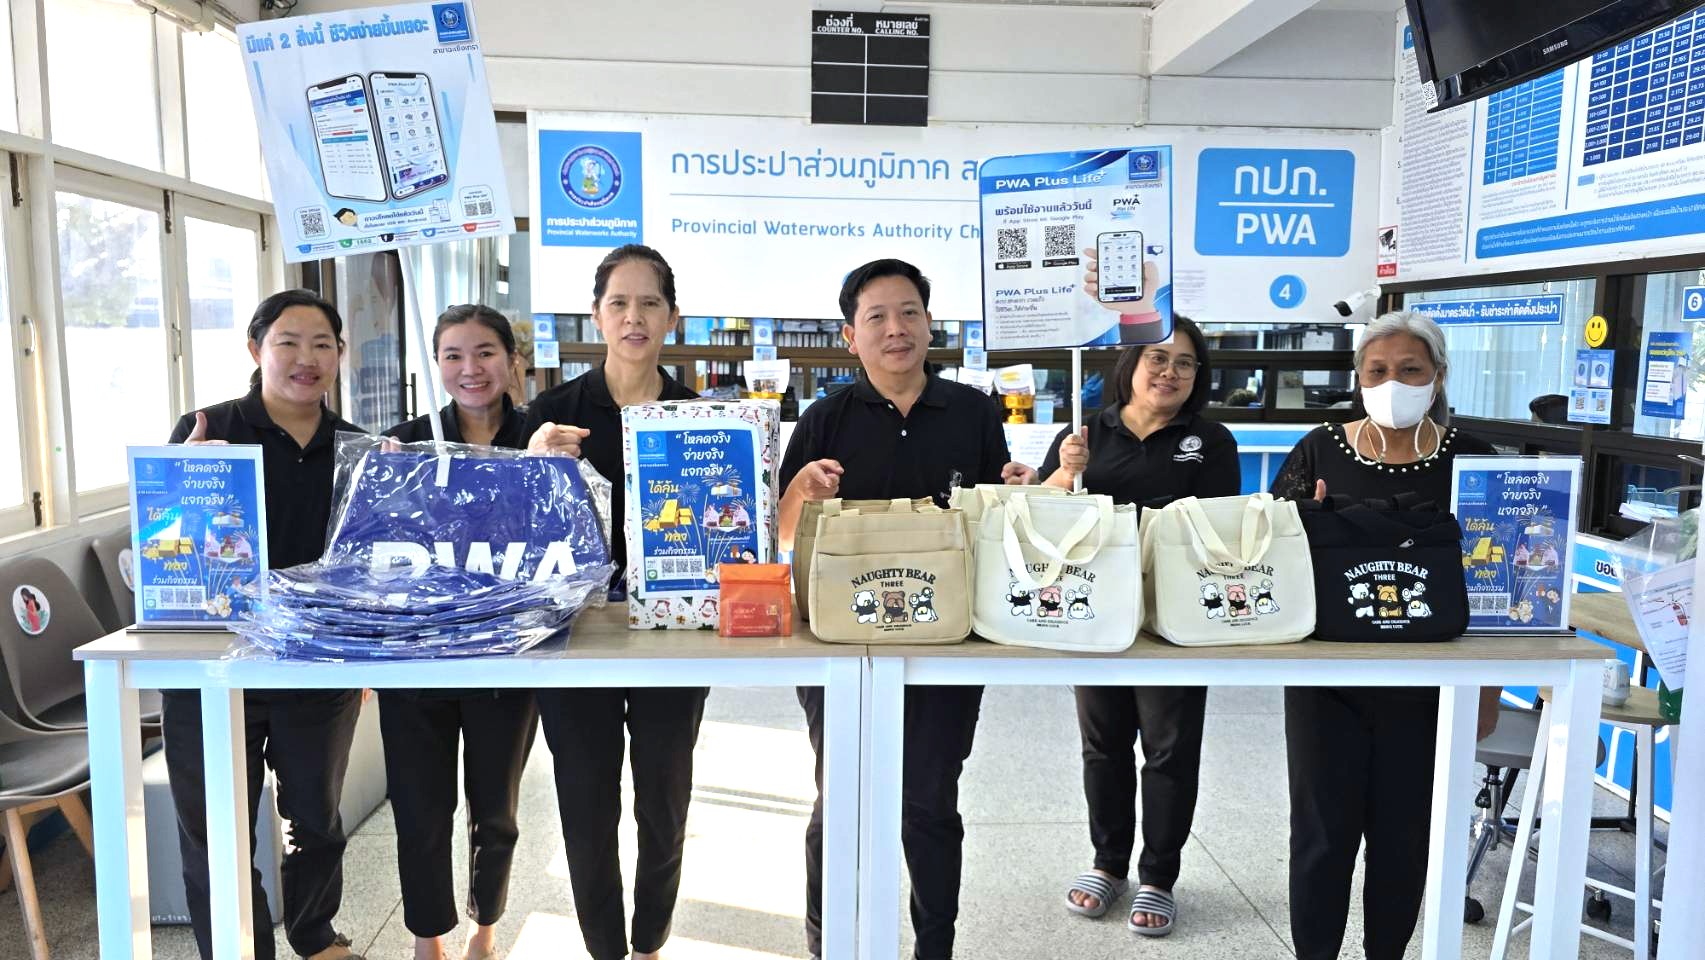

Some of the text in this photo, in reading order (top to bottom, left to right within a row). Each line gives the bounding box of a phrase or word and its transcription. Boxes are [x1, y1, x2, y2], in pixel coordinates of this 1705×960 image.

[826, 13, 918, 30] ช่องที่ หมายเลข
[246, 12, 430, 53] มีแค่ 2 สิ่งนี้ ชีวิตง่ายขึ้นเยอะ
[1542, 39, 1569, 55] SAMSUNG
[672, 148, 950, 188] การประปาส่วนภูมิภาค
[996, 177, 1031, 189] PWA
[1035, 176, 1069, 187] Plus
[1234, 158, 1328, 196] กปภ.
[995, 199, 1092, 216] พร้อมใช้งานแล้ววันนี้
[547, 216, 638, 230] การประปาส่วนภูมิภาค
[672, 218, 757, 235] Provincial
[764, 220, 865, 237] Waterworks
[872, 222, 953, 240] Authority
[1236, 212, 1317, 246] PWA
[996, 288, 1021, 296] PWA
[1278, 283, 1291, 300] 4
[682, 446, 724, 460] จ่ายจริง
[183, 475, 225, 489] จ่ายจริง
[648, 480, 680, 499] ได้ลุ้น
[1501, 488, 1541, 500] จ่ายจริง
[1464, 517, 1494, 535] ได้ลุ้น
[663, 530, 687, 542] ทอง
[653, 543, 697, 555] ร่วมกิจกรรม
[152, 574, 198, 585] ร่วมกิจกรรม
[852, 568, 937, 588] NAUGHTY BEAR
[1065, 564, 1097, 582] BEAR
[1344, 561, 1429, 581] NAUGHTY BEAR
[1373, 573, 1396, 581] THREE
[880, 580, 904, 588] THREE
